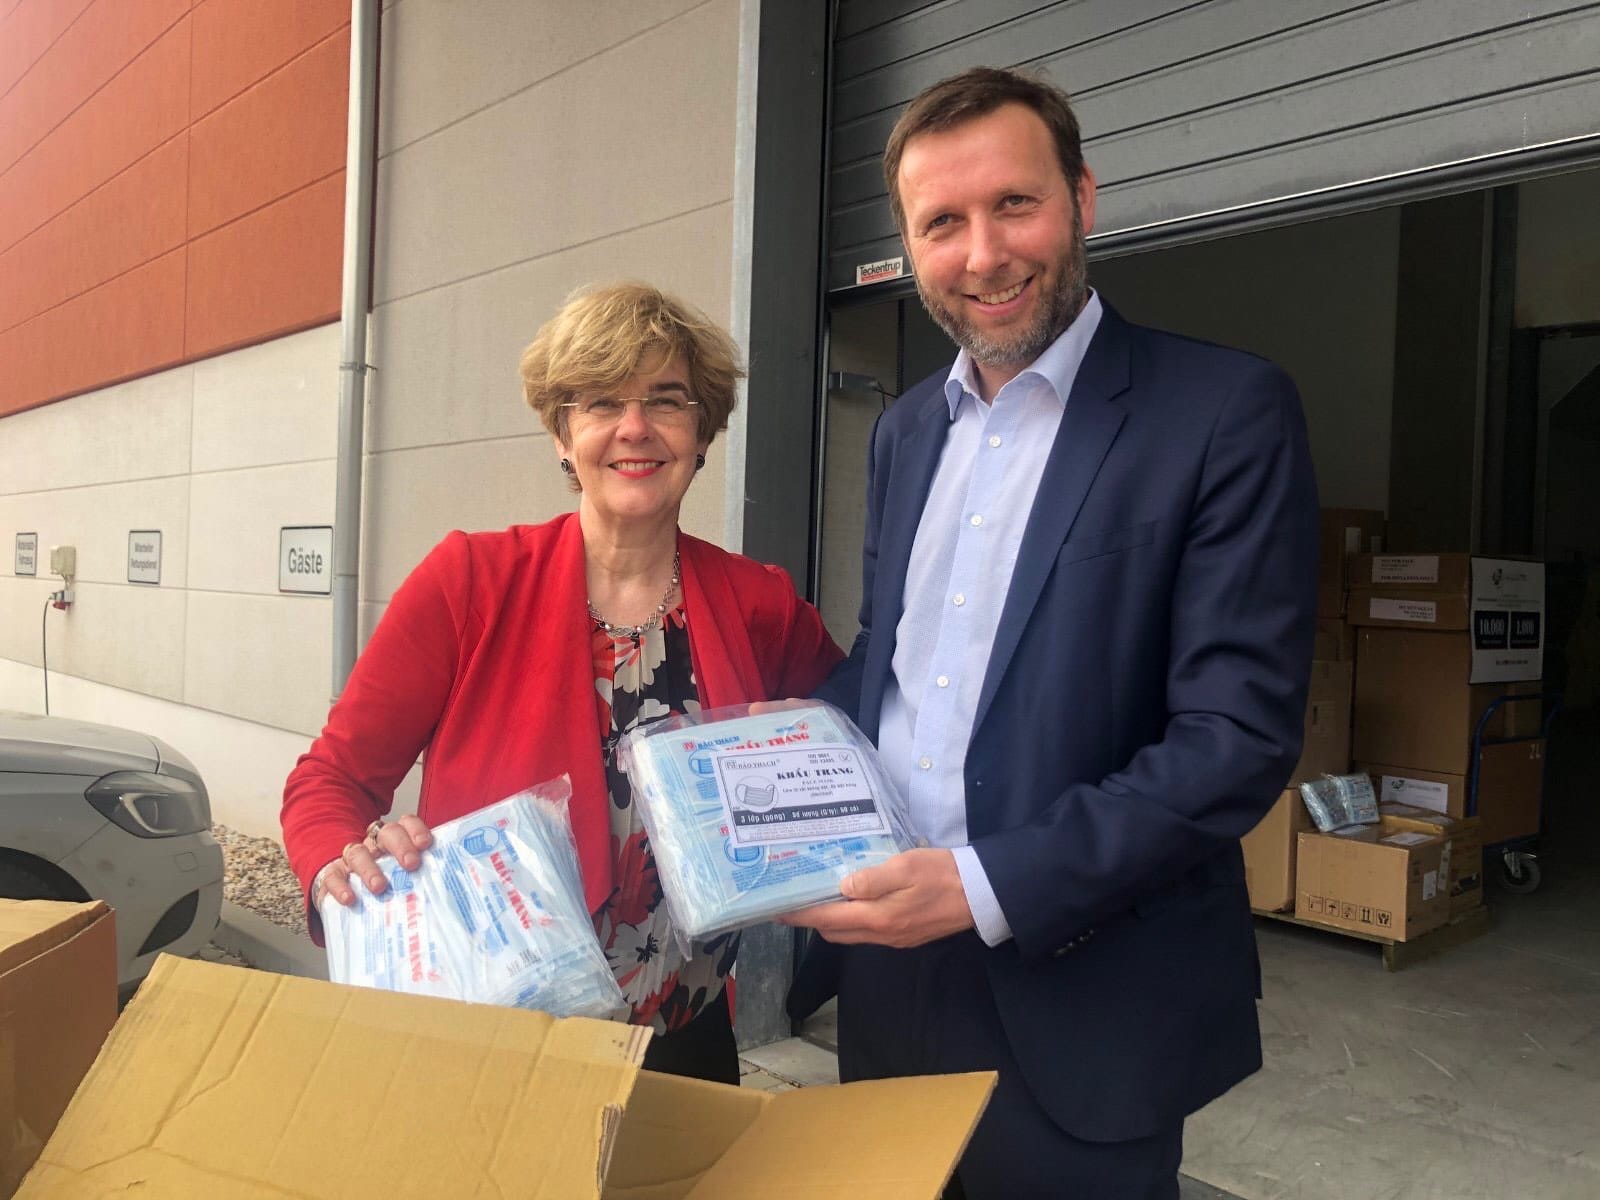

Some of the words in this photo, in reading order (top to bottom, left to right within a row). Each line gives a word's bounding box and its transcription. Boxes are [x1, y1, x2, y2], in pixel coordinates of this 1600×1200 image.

[860, 261, 900, 276] Teckentrup
[289, 547, 323, 574] Gäste
[814, 767, 854, 778] TRANG
[740, 815, 746, 824] 3
